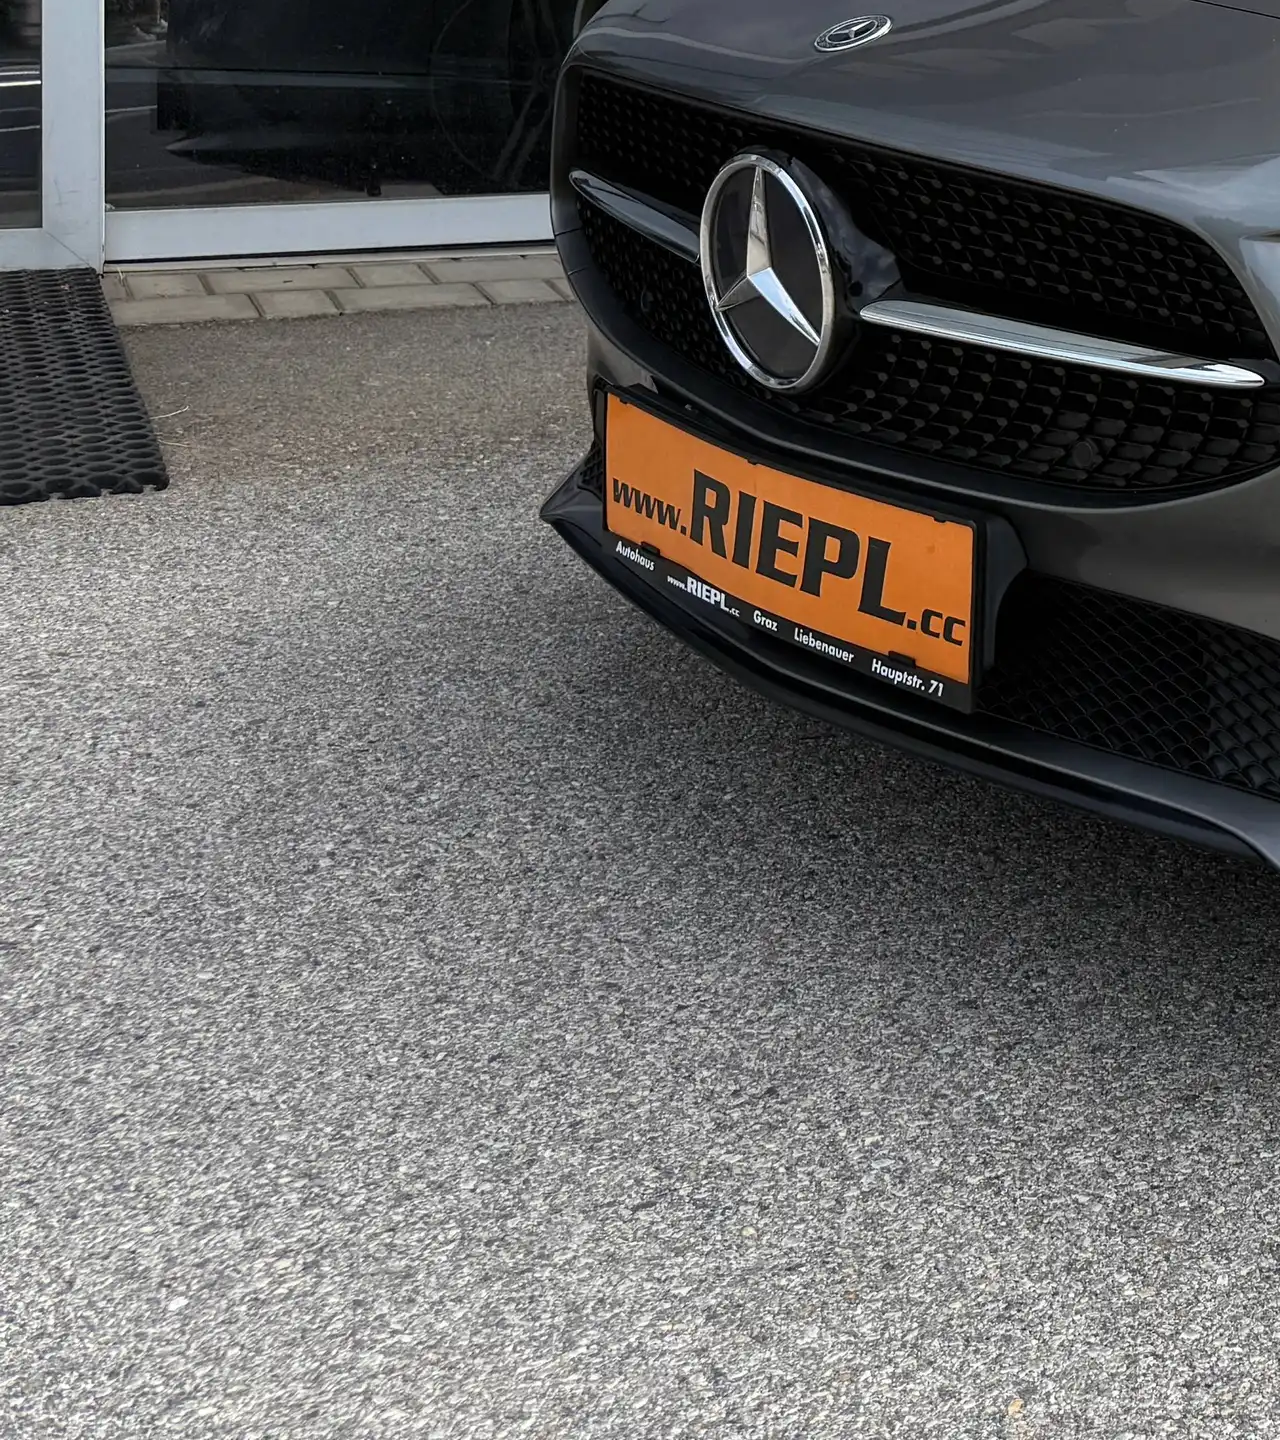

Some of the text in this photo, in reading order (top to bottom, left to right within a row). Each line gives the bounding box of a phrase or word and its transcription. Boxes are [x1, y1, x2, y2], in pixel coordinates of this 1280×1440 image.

[612, 468, 966, 647] www.RIEPL.cc
[615, 540, 944, 697] Autohaus www.RIEPL.cc Graz Liebenauer Hauptstr. 71
